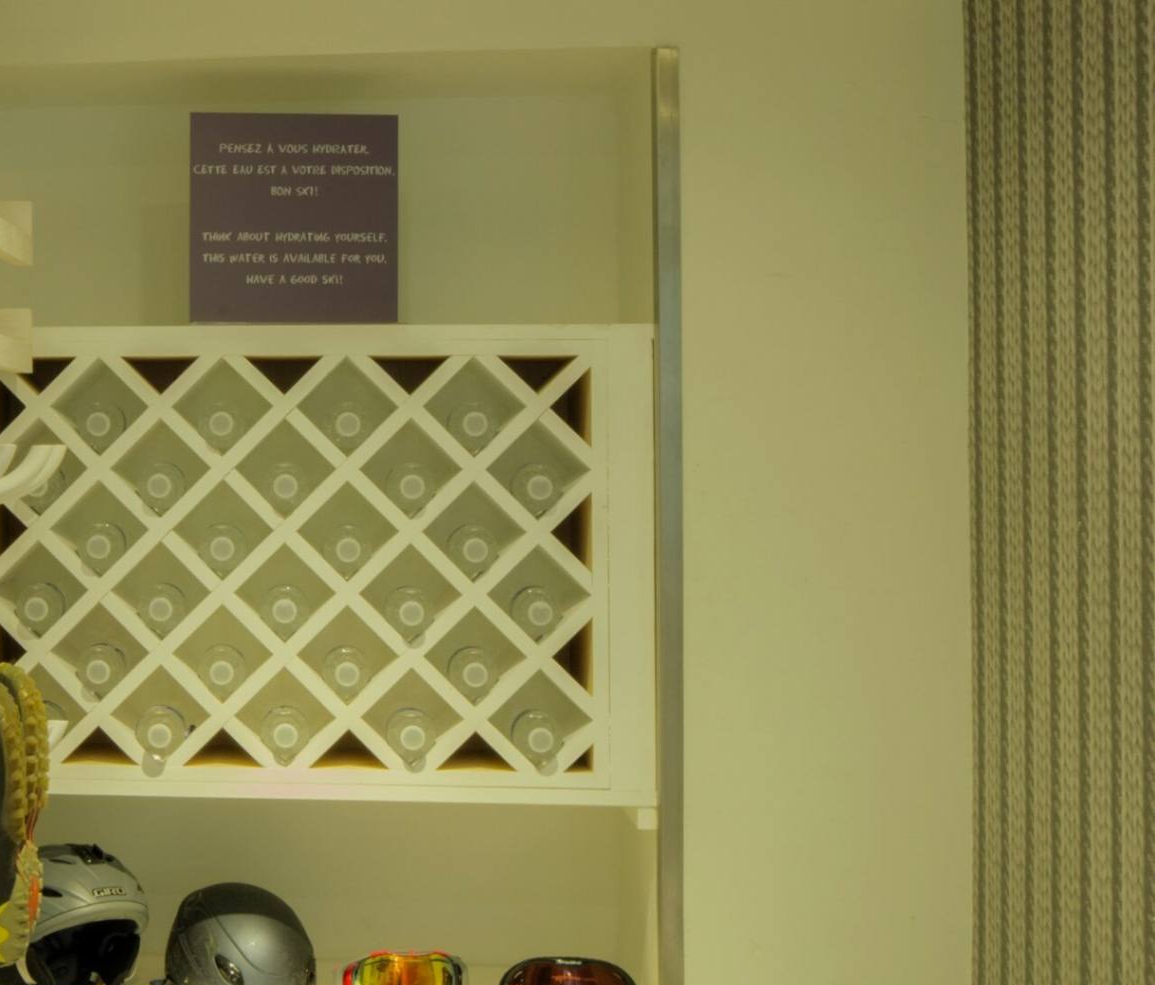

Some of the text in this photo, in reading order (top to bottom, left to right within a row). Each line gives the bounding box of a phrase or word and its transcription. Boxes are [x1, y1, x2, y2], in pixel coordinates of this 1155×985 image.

[219, 143, 262, 154] PENSEZ
[278, 143, 308, 155] VOUS
[193, 164, 227, 176] CETTE
[232, 165, 253, 175] EAU
[257, 165, 276, 175] EST
[291, 165, 326, 176] VOTRE
[270, 186, 292, 196] BON
[202, 231, 388, 243] THINK ABOUT HYDRATING YOURSELF.
[202, 253, 387, 265] THIS WATER IS AVAILABLE FOR YOU.
[246, 275, 344, 285] HAVE A GOOD SKI!
